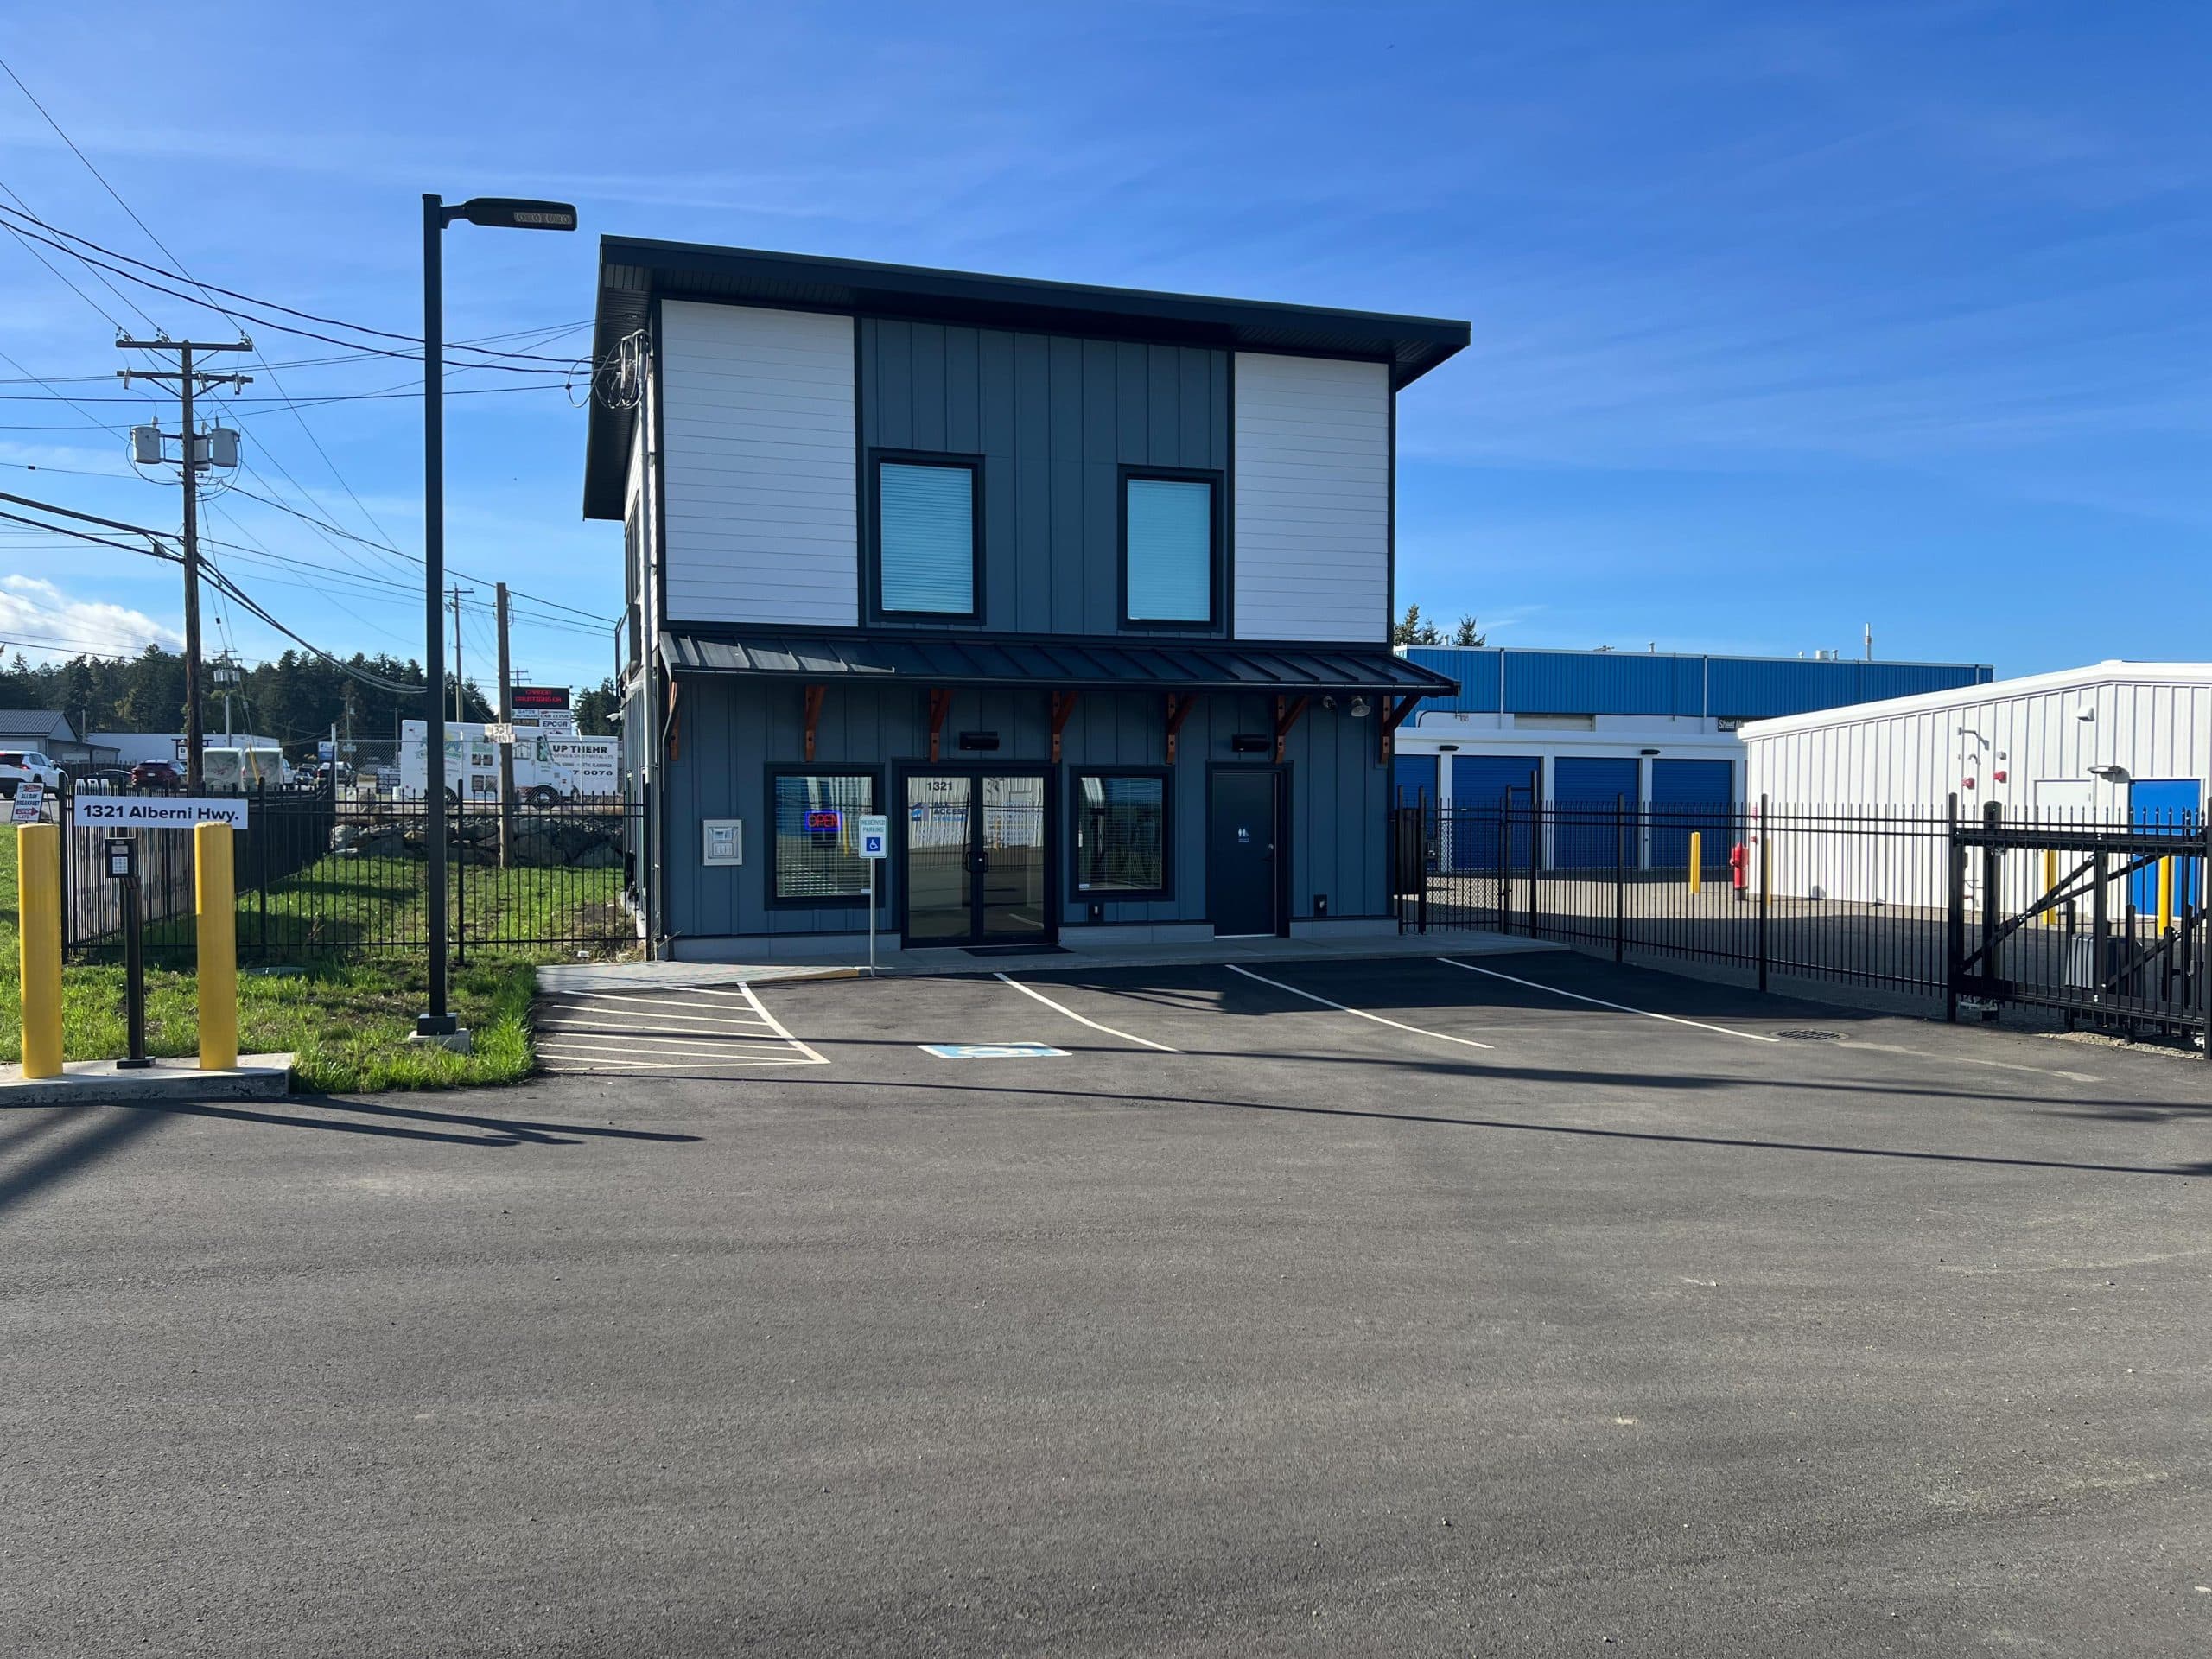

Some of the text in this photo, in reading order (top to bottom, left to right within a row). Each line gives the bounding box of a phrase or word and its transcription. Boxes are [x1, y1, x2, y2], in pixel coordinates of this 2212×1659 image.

[927, 781, 953, 791] 1321
[83, 804, 239, 823] 1321 Alberni Hwy.
[809, 813, 839, 827] OPEN
